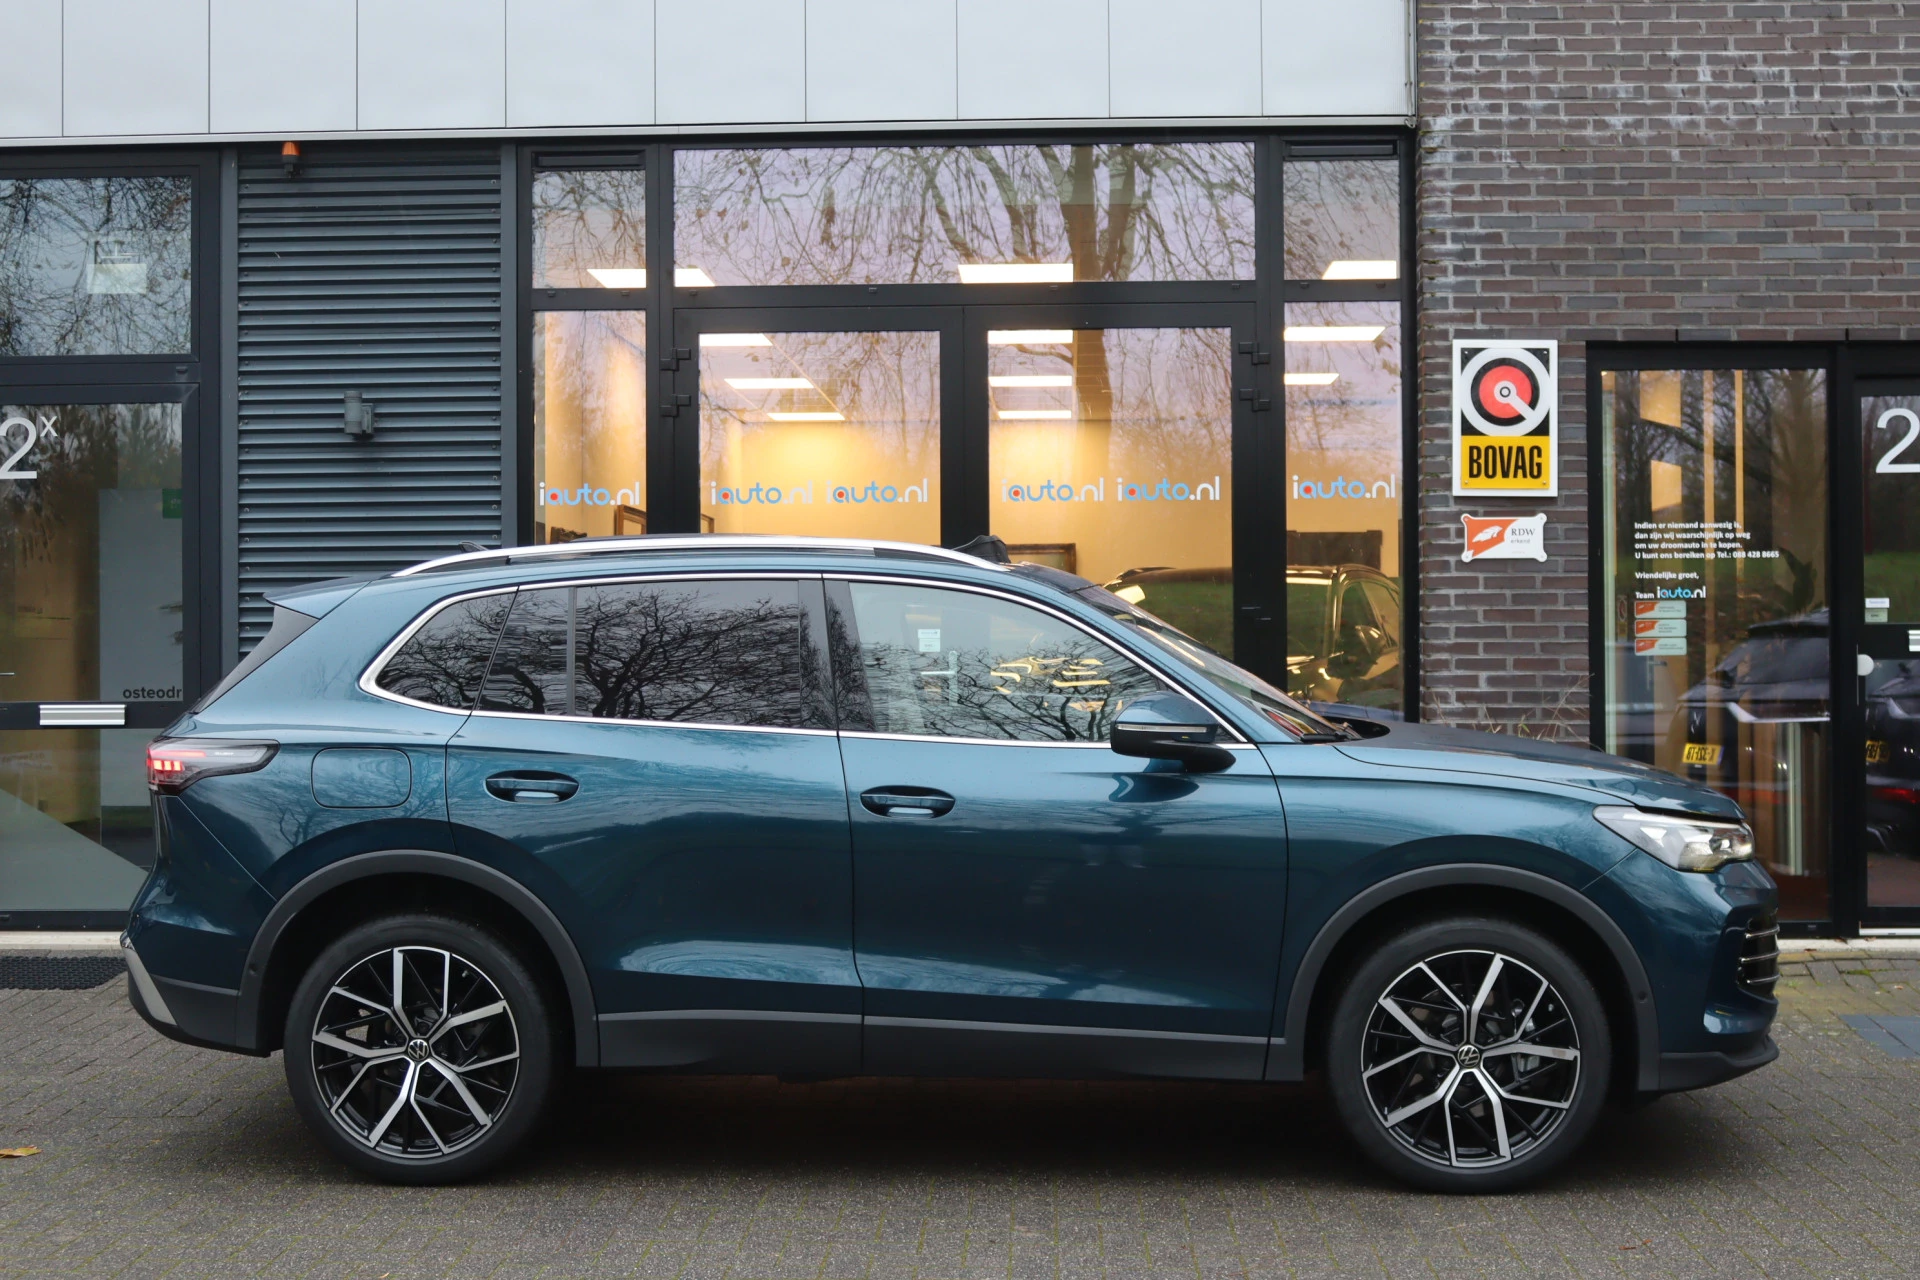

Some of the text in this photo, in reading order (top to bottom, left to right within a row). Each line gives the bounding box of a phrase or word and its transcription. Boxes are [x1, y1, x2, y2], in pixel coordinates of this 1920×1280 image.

[1876, 408, 1920, 473] 2
[1468, 445, 1542, 479] BOVAG
[539, 481, 640, 506] iauto.nl
[1117, 476, 1220, 502] iauto.nl
[1293, 474, 1396, 500] iauto.nl
[1511, 528, 1536, 536] RDW
[1634, 521, 1657, 529] Indien
[1667, 521, 1699, 529] niemand
[1700, 521, 1733, 530] aanwezig
[1634, 531, 1751, 540] dan zijn wij waarschijnlijk op weg
[1660, 541, 1700, 549] droomauto
[1701, 541, 1709, 549] in
[1709, 541, 1717, 549] te
[1673, 551, 1705, 559] bereiken
[1635, 571, 1677, 579] Vriendelijke
[1635, 586, 1707, 599] Team iauto.nl
[122, 685, 183, 699] osteodr
